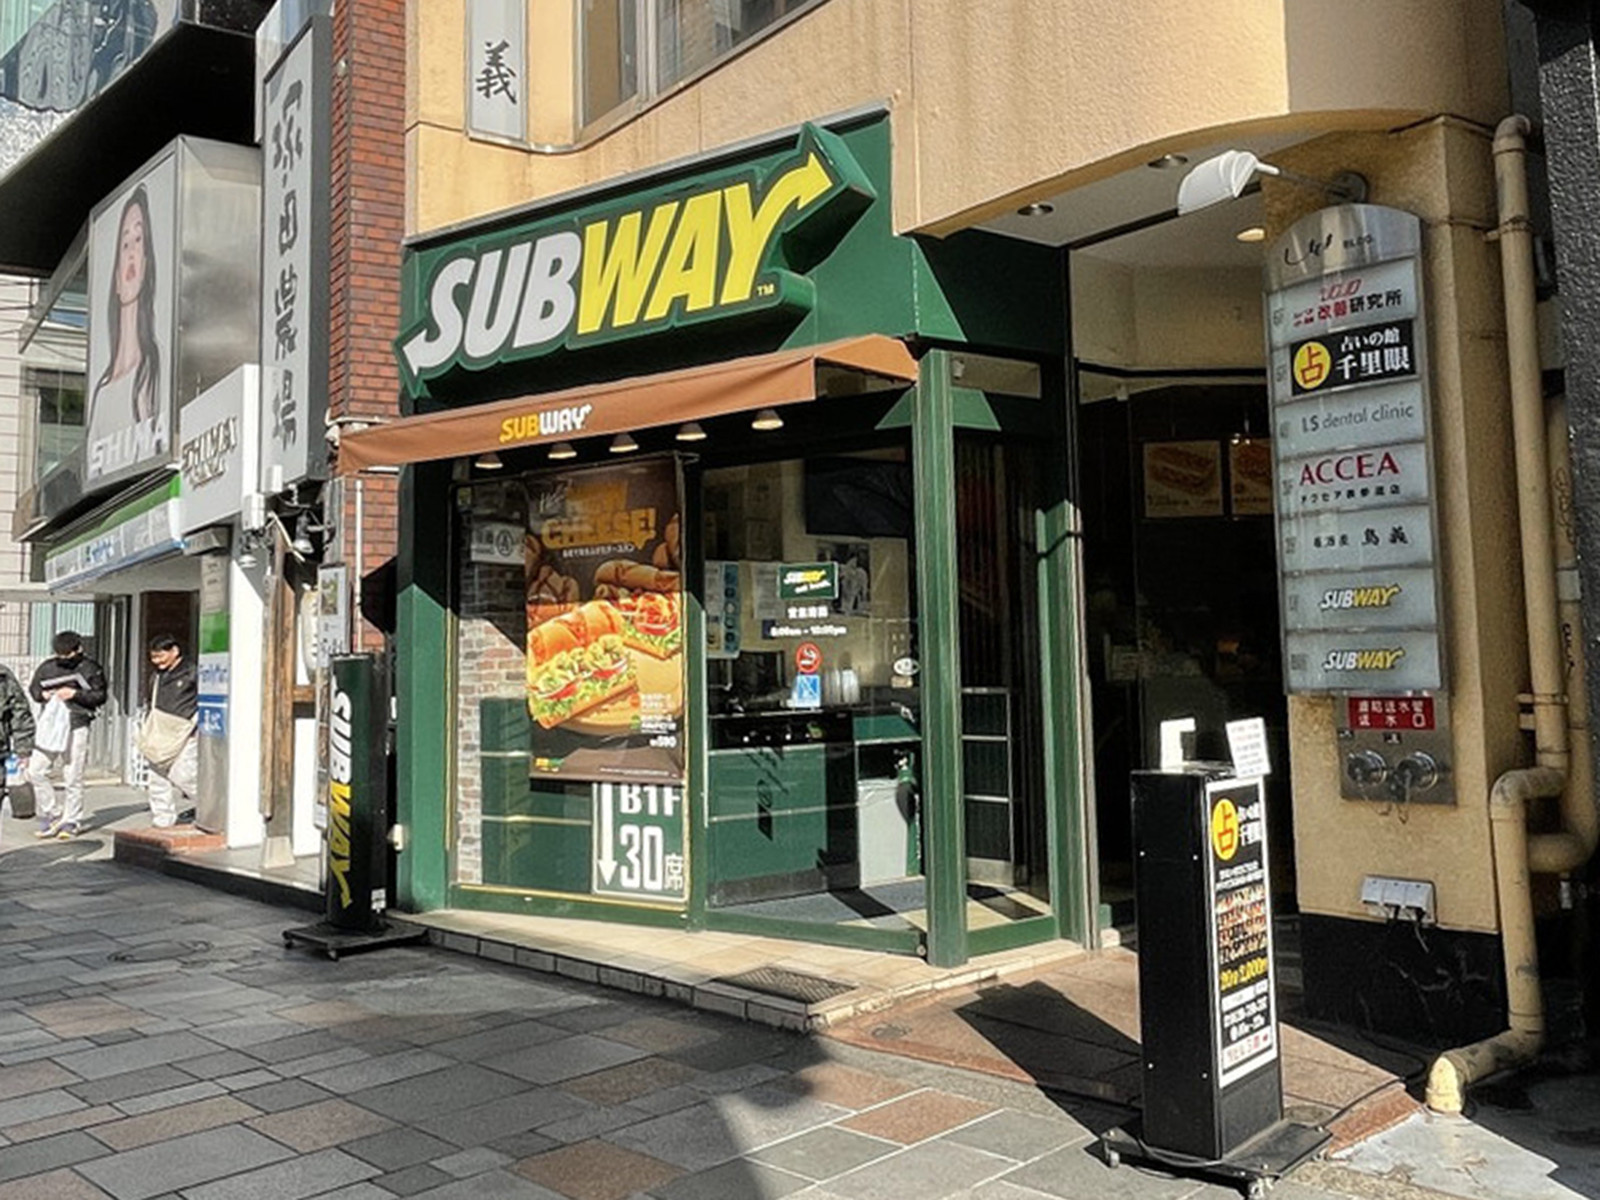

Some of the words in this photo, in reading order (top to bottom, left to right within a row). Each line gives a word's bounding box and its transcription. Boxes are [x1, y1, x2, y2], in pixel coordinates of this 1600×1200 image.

[476, 40, 517, 105] 義
[402, 152, 833, 377] SUBWAY
[1335, 345, 1410, 379] 千里眼
[499, 403, 593, 443] SUBWAY
[1322, 407, 1368, 429] dental
[1371, 402, 1414, 422] clinic
[1299, 452, 1400, 486] ACCEA
[1320, 583, 1401, 610] SUBWAY
[1323, 647, 1405, 671] SUBWAY
[330, 674, 352, 909] SUBWAY
[619, 783, 681, 816] B1F
